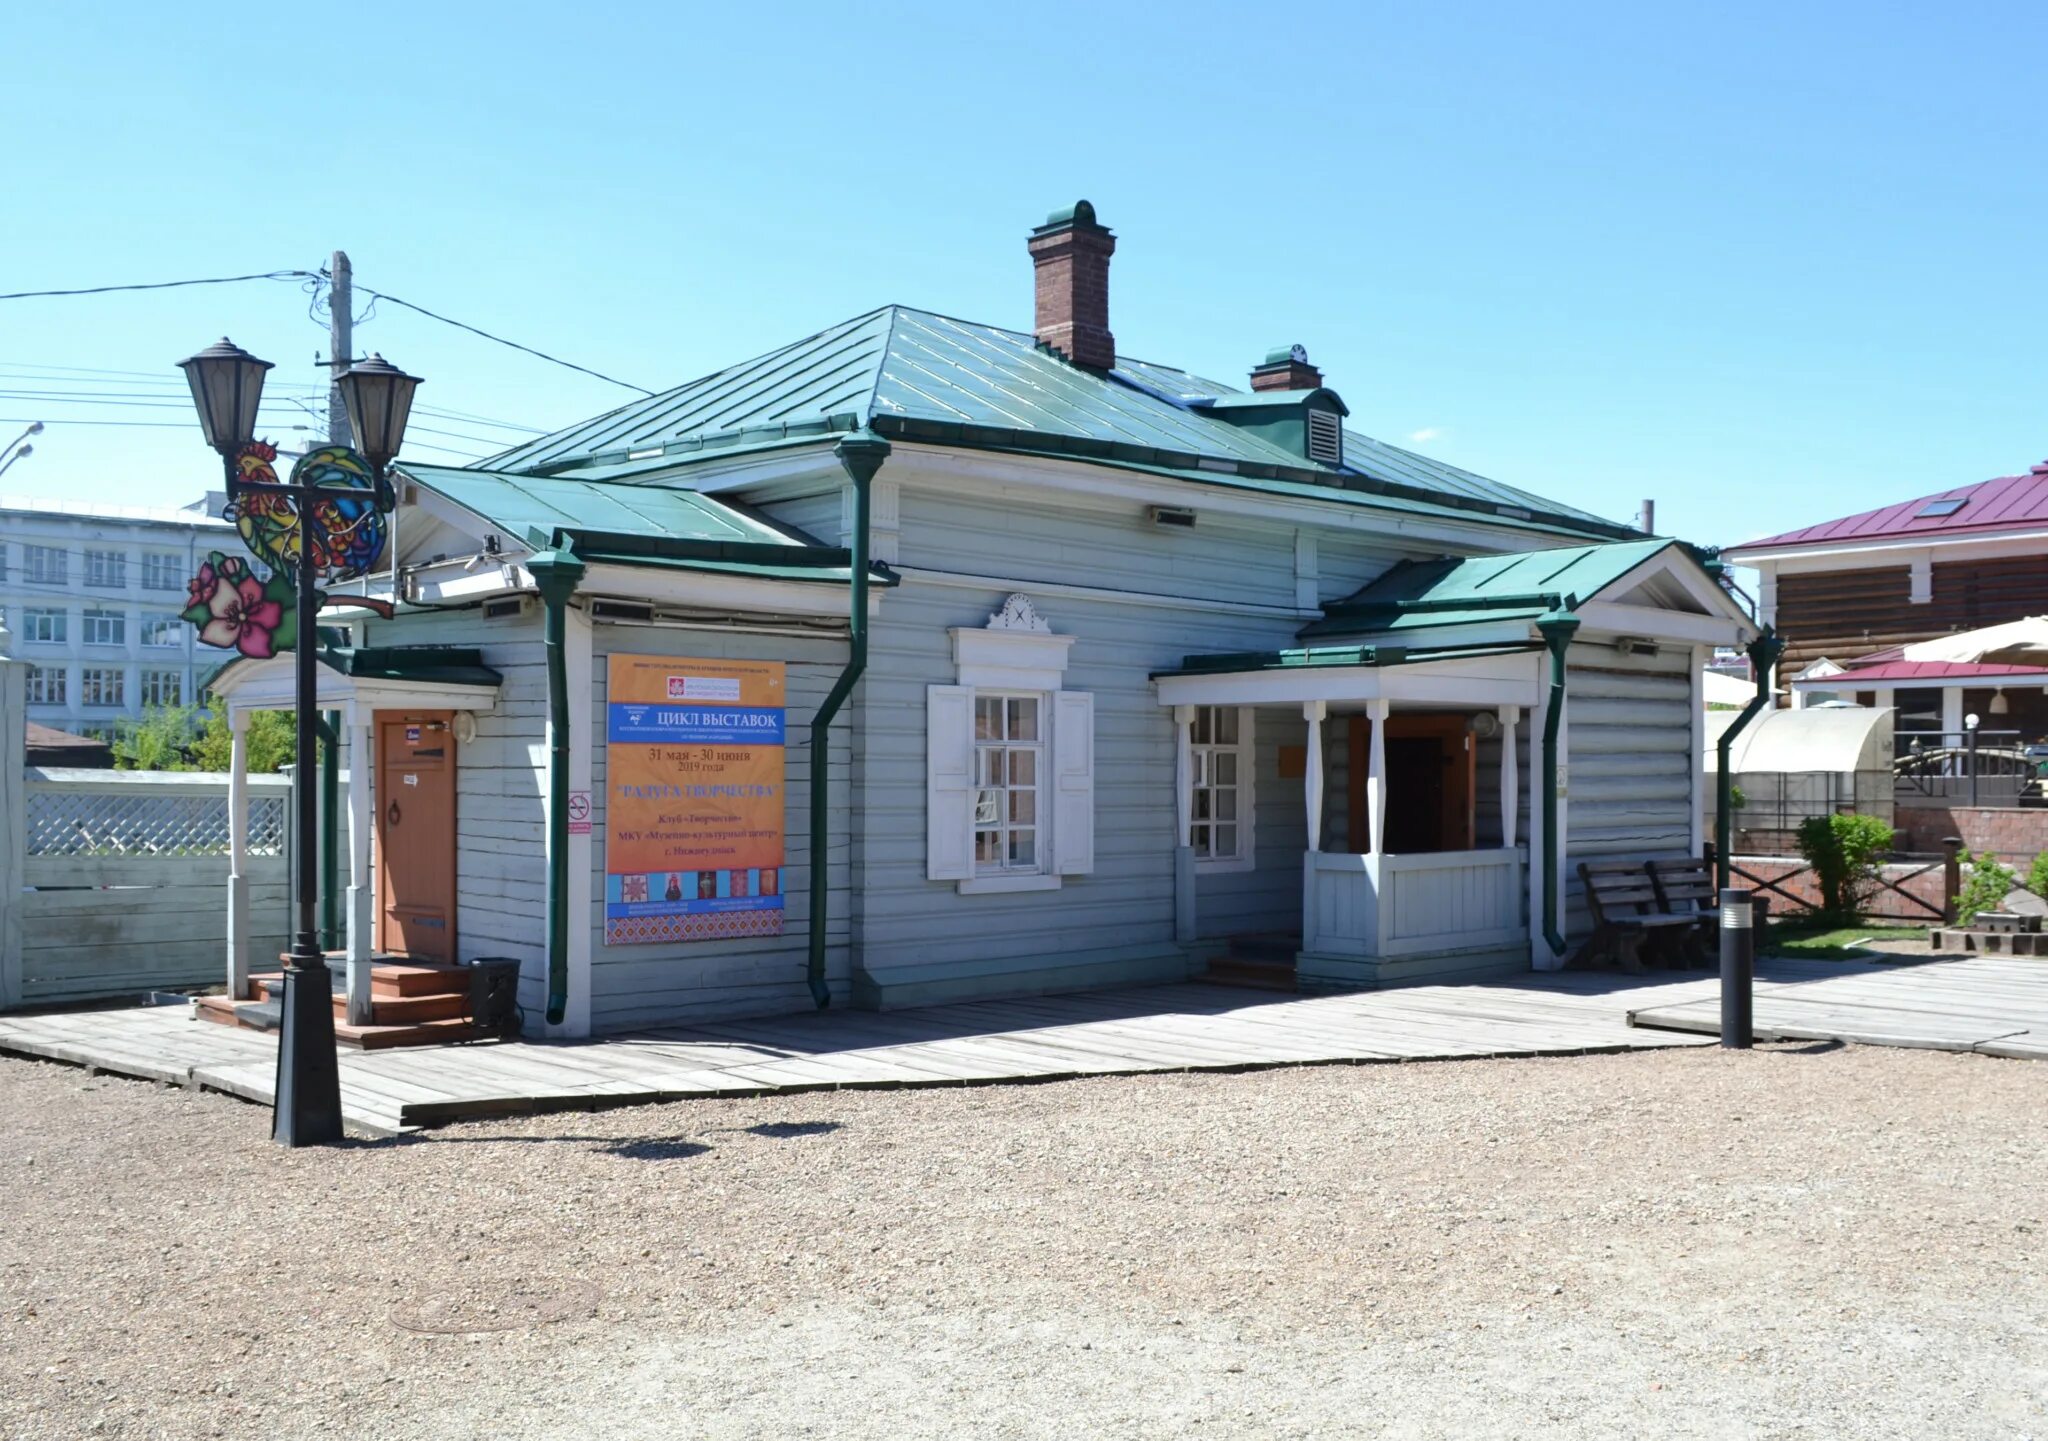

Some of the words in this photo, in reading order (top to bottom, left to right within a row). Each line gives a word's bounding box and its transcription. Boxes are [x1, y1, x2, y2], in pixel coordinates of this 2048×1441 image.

[657, 712, 699, 727] ЦИКЛ
[702, 713, 777, 727] ВЫСТАВОК
[649, 748, 661, 761] 31
[666, 751, 689, 761] мая
[701, 749, 713, 761] 30
[717, 751, 751, 761] июня
[678, 762, 700, 772] 2019
[703, 763, 724, 772] года
[658, 815, 682, 824] Клуб
[618, 831, 641, 841] МКУ
